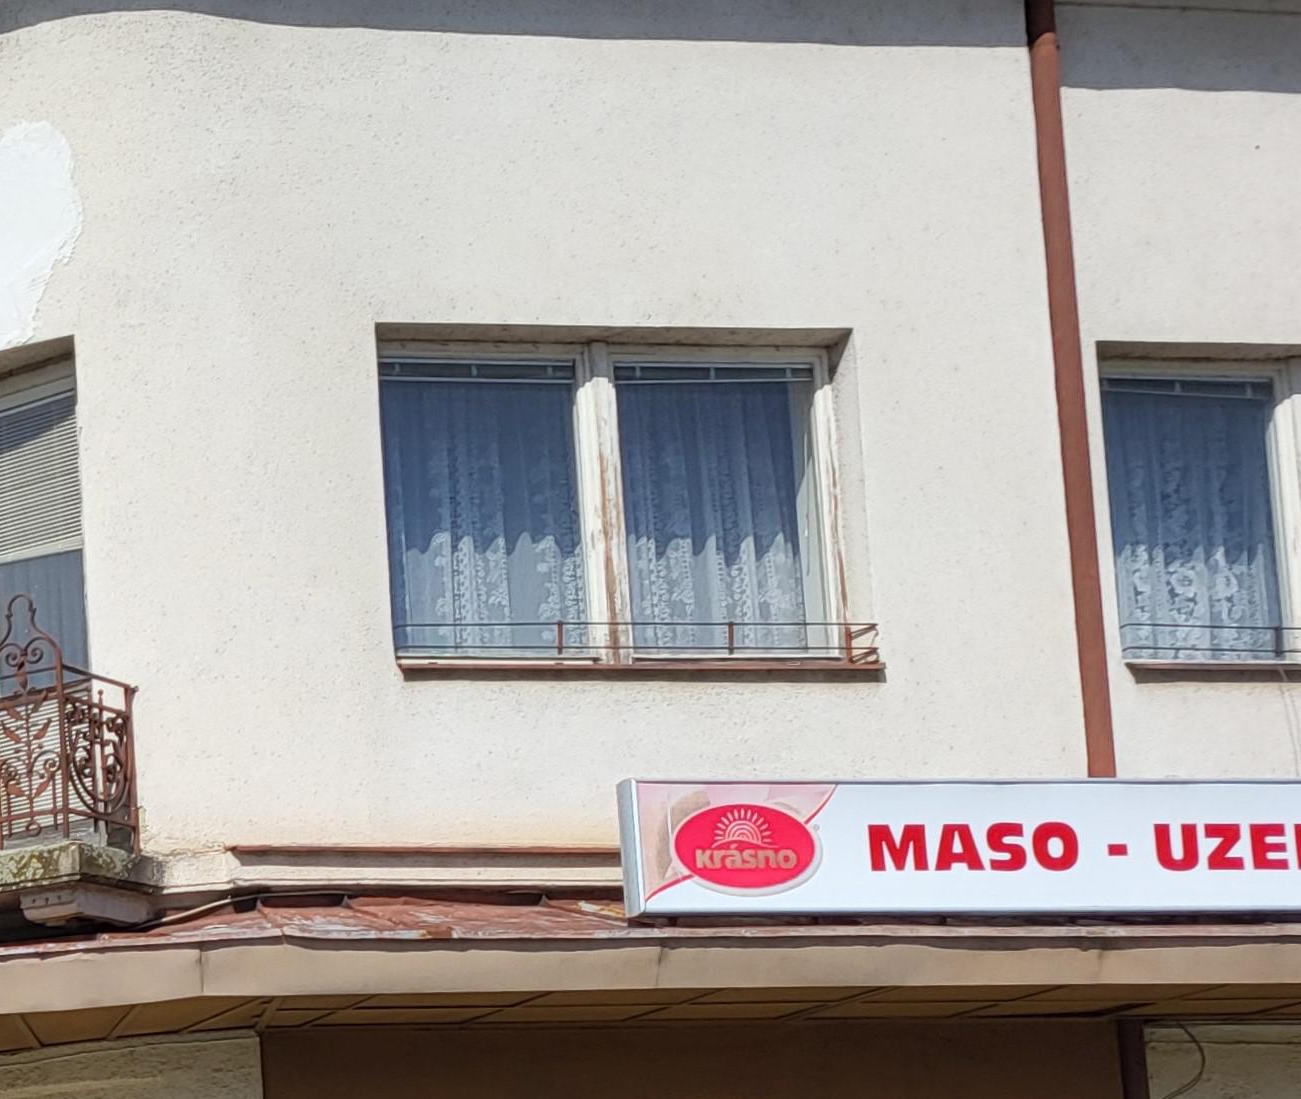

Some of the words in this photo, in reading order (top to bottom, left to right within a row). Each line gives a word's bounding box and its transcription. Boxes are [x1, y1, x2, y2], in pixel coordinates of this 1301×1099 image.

[694, 843, 797, 869] Krásno
[867, 821, 1079, 872] MASO
[1107, 844, 1128, 856] -
[1153, 823, 1301, 871] UZE
